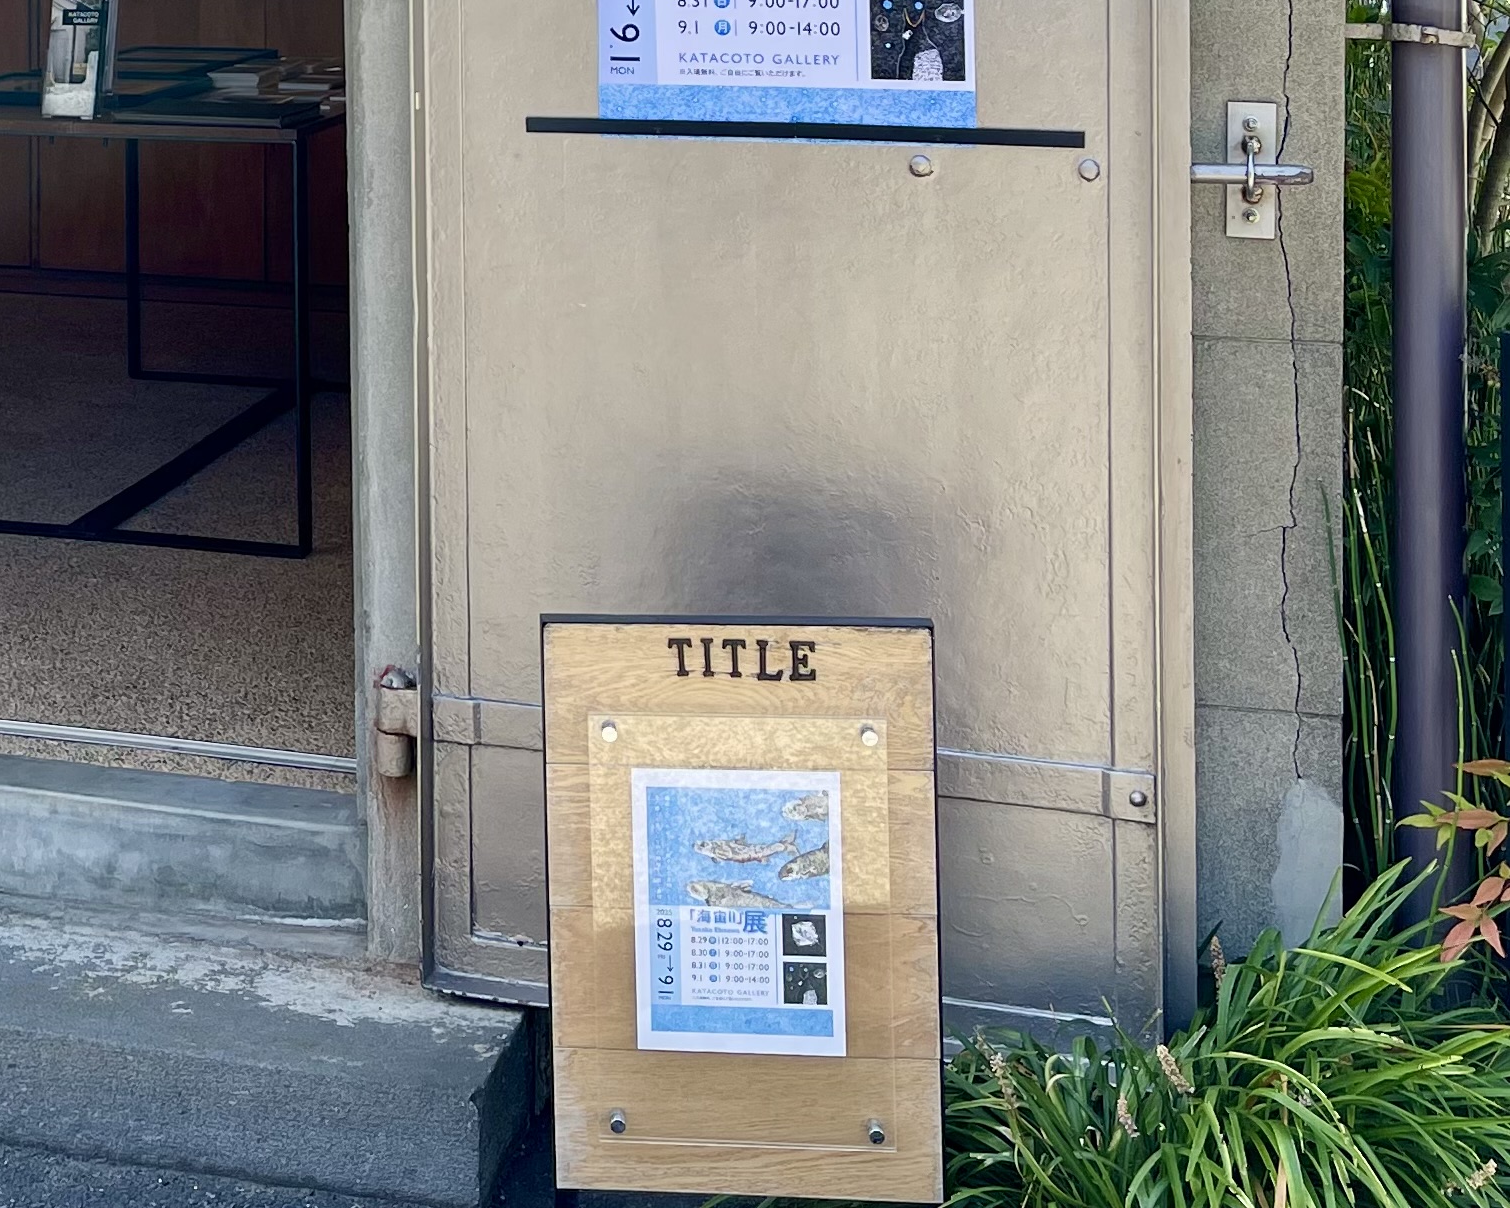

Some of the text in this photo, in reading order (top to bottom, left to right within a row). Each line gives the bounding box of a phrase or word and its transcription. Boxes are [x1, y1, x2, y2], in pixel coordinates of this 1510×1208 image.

[678, 20, 699, 35] 9.1
[748, 21, 841, 36] 9:00-14:00
[678, 52, 840, 66] KATACOTO GALLERY
[610, 66, 635, 75] MON
[667, 637, 817, 682] TITLE
